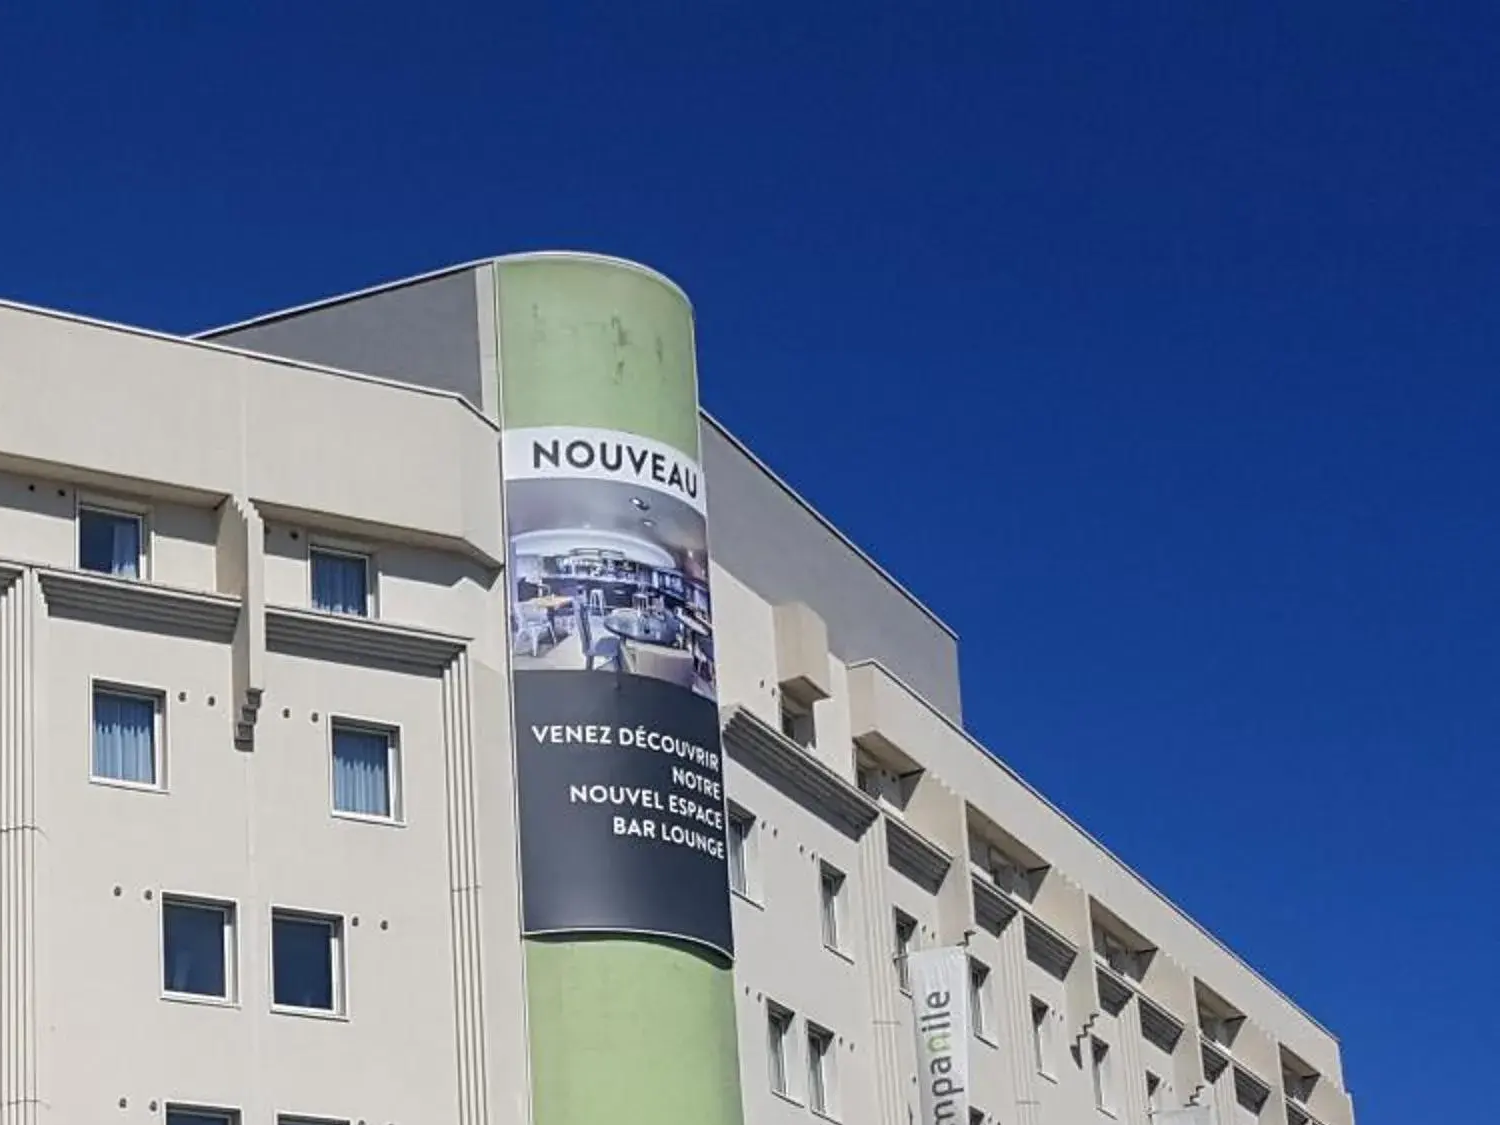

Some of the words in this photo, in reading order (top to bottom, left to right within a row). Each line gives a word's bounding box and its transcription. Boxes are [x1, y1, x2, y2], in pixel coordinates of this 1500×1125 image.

[533, 439, 697, 498] NOUVEAU
[531, 725, 612, 744] VENEZ
[618, 725, 719, 772] DÉCOUVRIR
[672, 766, 721, 801] NOTRE
[569, 784, 664, 810] NOUVEL
[668, 795, 723, 831] ESPACE
[612, 816, 656, 839] BAR
[660, 823, 725, 860] LOUNGE
